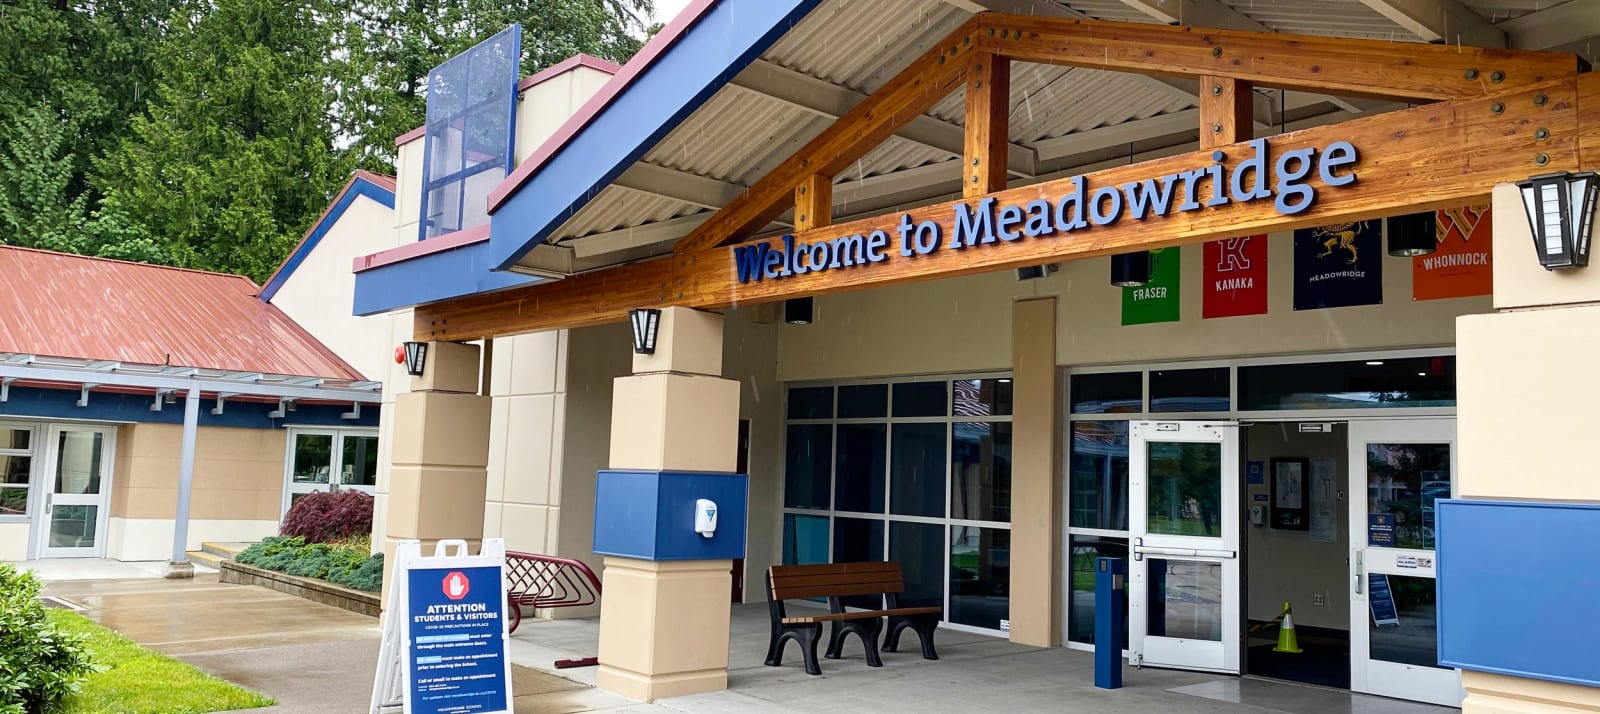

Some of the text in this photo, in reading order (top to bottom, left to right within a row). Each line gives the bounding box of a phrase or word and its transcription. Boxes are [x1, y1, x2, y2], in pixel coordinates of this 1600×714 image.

[734, 137, 1359, 284] Welcome to Meadowridge
[1217, 236, 1250, 272] K
[1423, 252, 1489, 271] WHONNOCK
[1309, 271, 1366, 283] MEADOWRIDGE
[1215, 277, 1253, 292] KANAKA
[1133, 287, 1167, 301] FRASER
[428, 604, 486, 614] ATTENTION
[415, 615, 455, 623] STUDENTS
